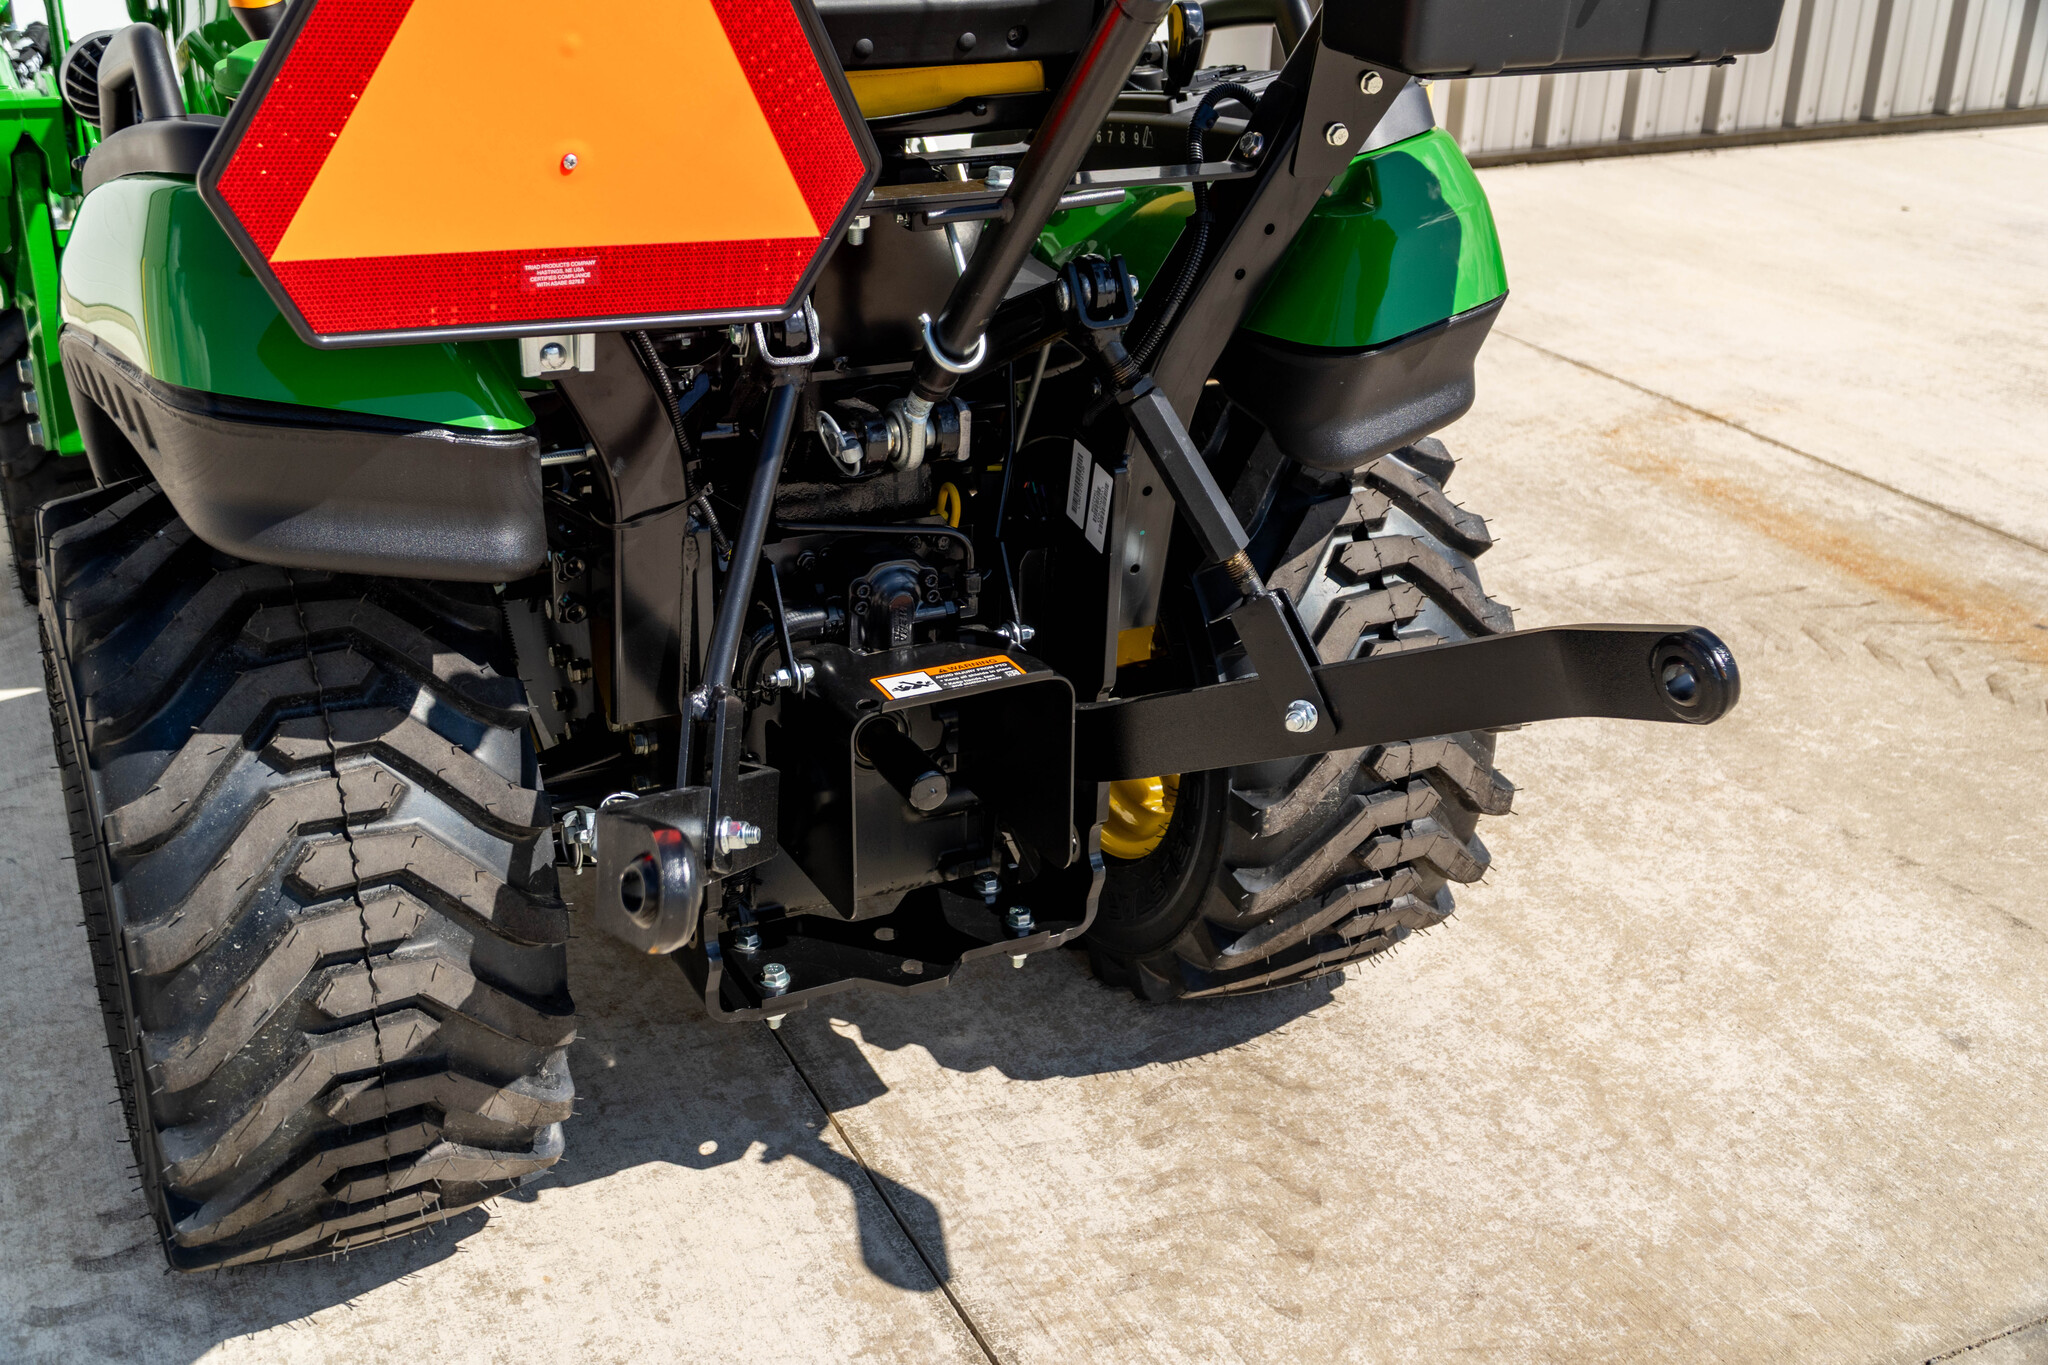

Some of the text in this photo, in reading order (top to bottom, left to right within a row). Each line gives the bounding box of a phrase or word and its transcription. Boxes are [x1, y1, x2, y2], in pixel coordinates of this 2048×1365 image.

[1096, 130, 1140, 145] 6 7 8 9
[947, 660, 998, 670] WARNING
